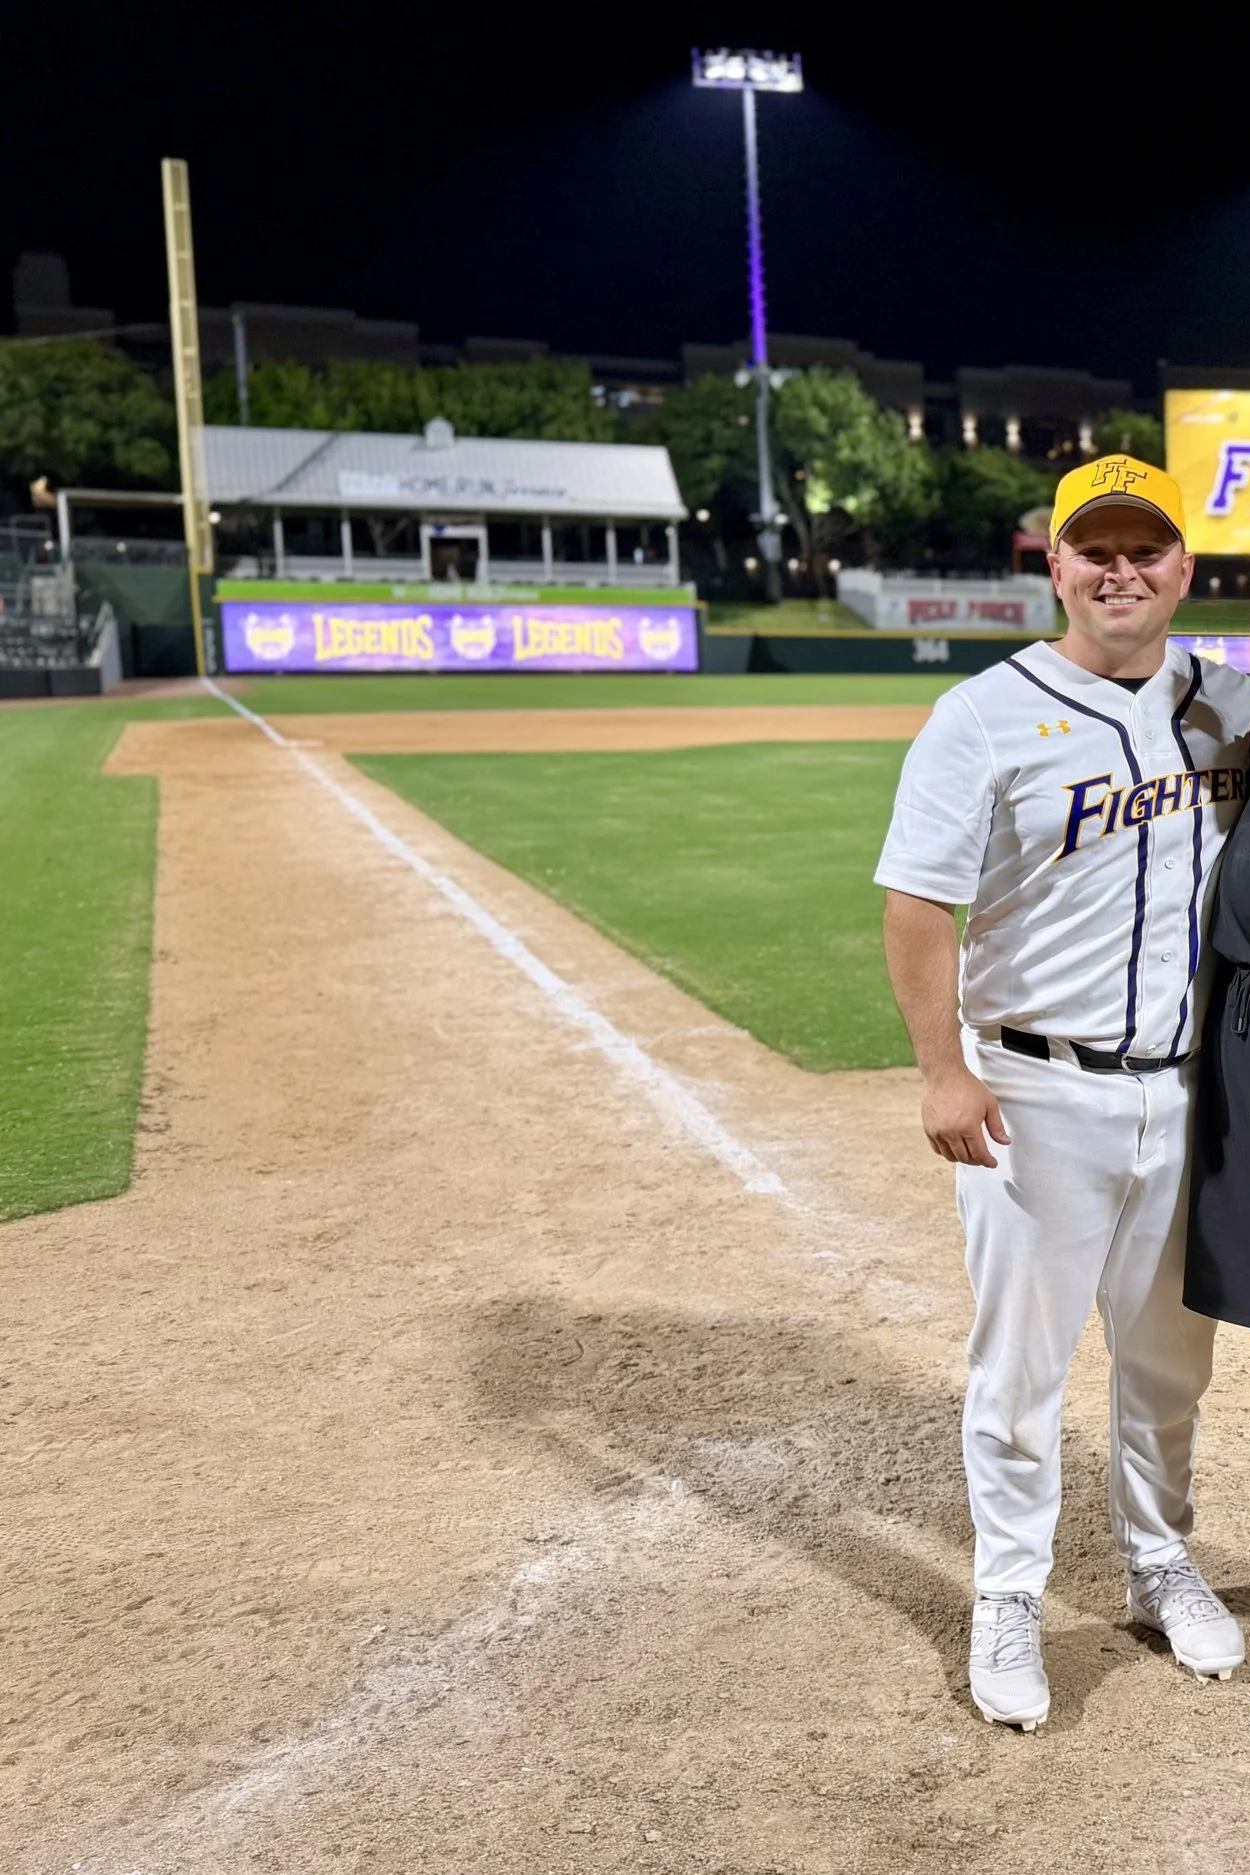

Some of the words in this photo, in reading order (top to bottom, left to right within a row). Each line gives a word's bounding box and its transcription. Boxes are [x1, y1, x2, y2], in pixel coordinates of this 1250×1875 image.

[312, 613, 435, 661] LEGENDS
[512, 615, 624, 661] LEGENDS
[1053, 768, 1247, 864] FIGHTER
